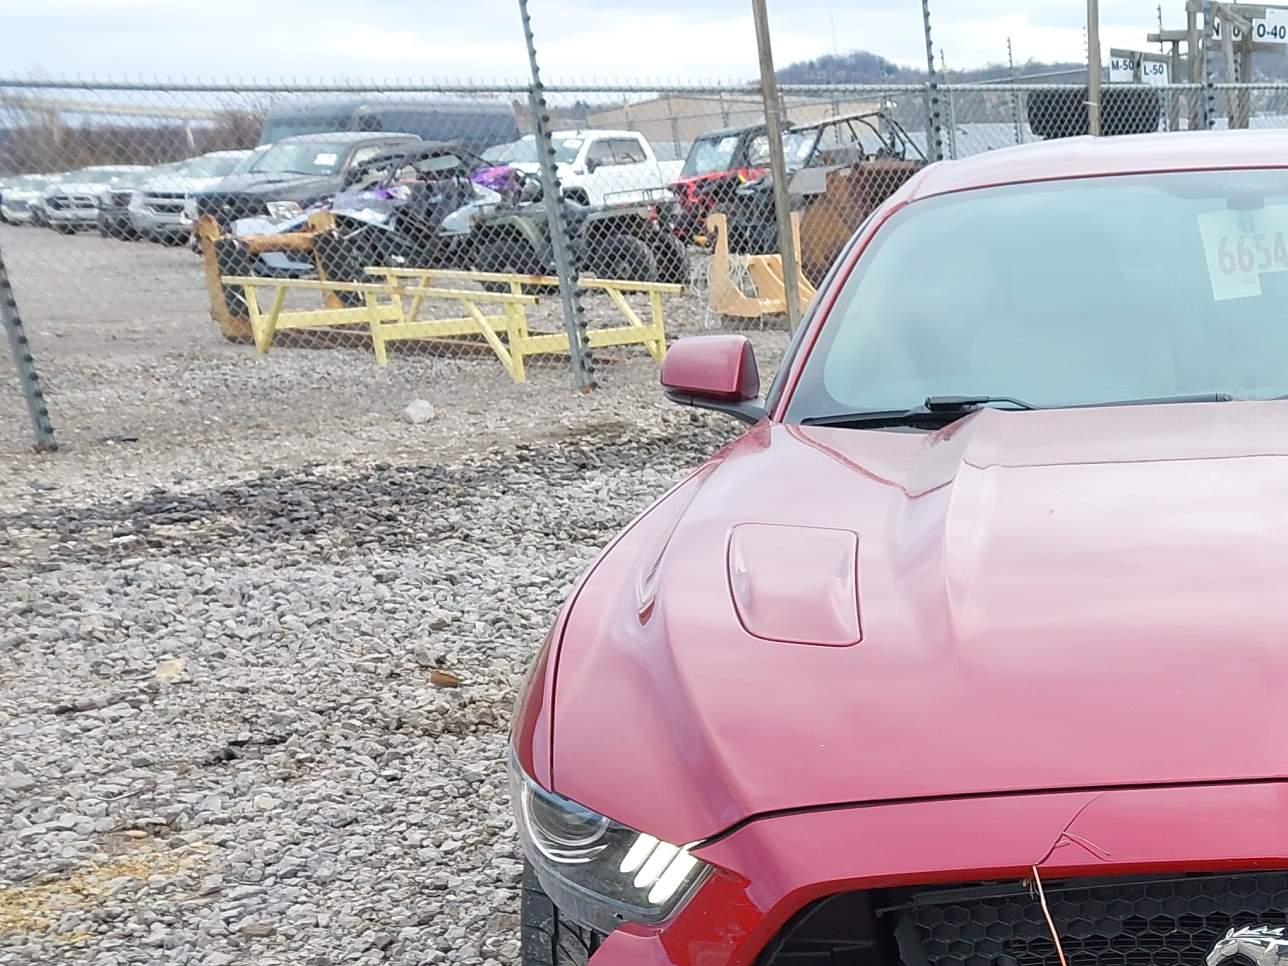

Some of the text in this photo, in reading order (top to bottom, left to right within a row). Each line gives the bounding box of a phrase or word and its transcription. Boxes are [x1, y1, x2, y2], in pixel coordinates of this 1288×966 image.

[1257, 23, 1287, 39] O-40
[1111, 59, 1135, 71] M-50
[1143, 64, 1164, 76] L-50
